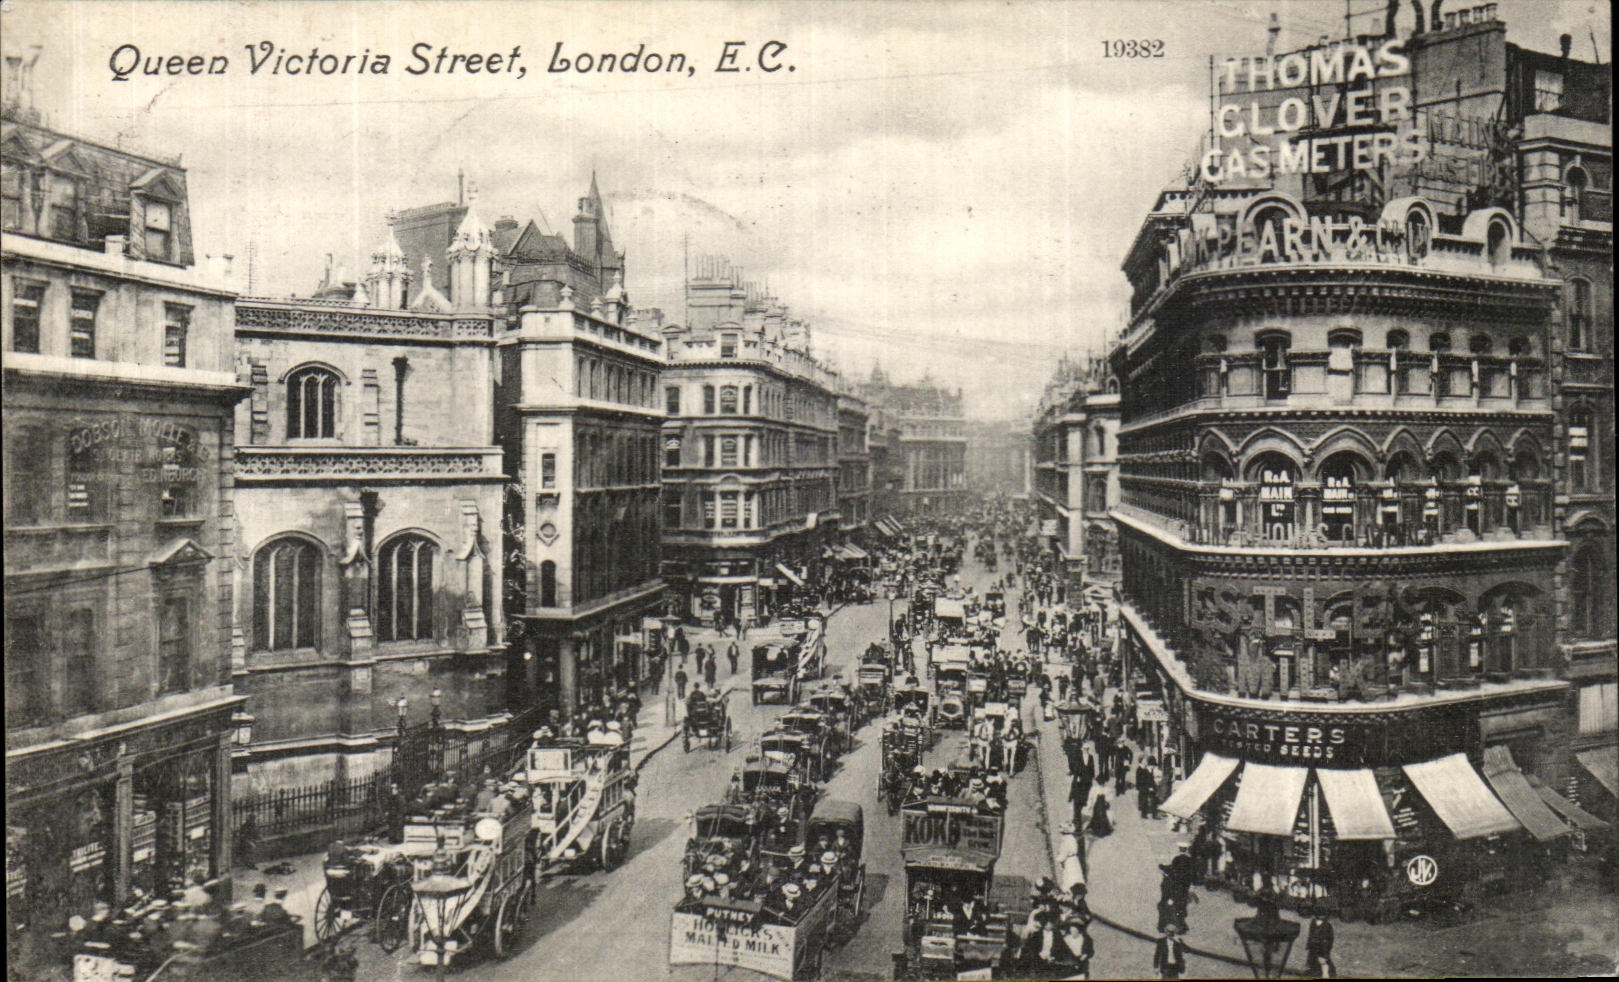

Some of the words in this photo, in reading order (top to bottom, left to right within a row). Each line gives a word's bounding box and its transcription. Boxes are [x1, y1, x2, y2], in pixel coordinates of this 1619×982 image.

[1221, 39, 1412, 93] THOMAS
[1217, 86, 1412, 138] GLOVER
[1279, 129, 1428, 173] METERS
[1216, 214, 1334, 262] PEARN
[1261, 486, 1293, 500] MAIN
[1213, 718, 1346, 744] CARTERS
[1279, 744, 1335, 759] SEEDS
[706, 907, 755, 923] PUTNEY
[745, 939, 780, 955] MILK
